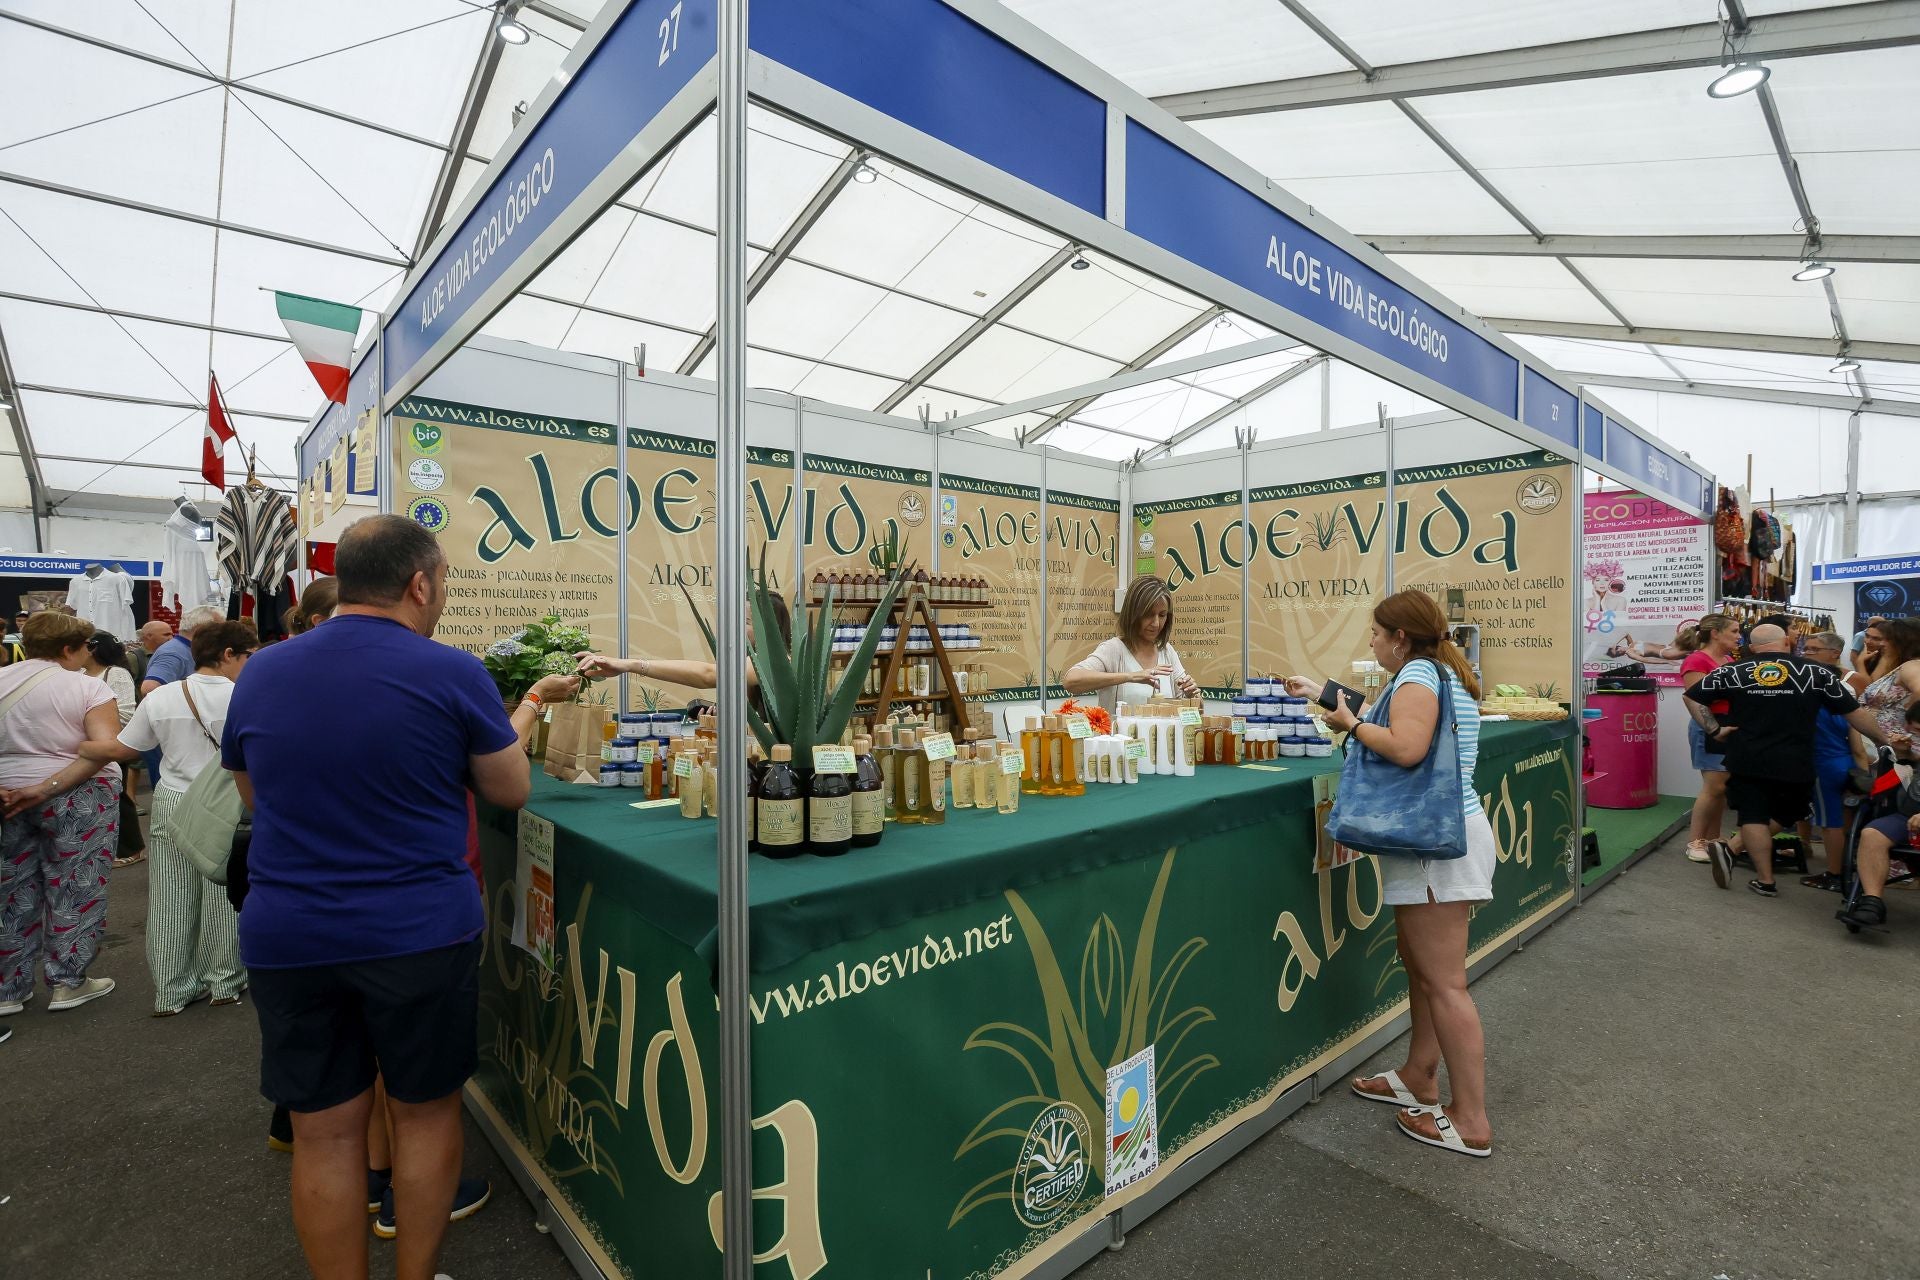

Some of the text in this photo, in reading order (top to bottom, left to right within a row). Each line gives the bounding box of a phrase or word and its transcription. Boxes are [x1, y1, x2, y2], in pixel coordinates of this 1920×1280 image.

[657, 0, 682, 67] 27
[421, 147, 555, 332] ALOE VIDA ECOLÓGICO
[1266, 235, 1448, 363] ALOE VIDA ECOLÓGICO
[1551, 404, 1559, 421] 27
[415, 427, 439, 441] bio
[29, 560, 81, 570] OCCITANIE
[648, 563, 712, 586] ALOE
[1831, 561, 1911, 575] LIMPIADOR PULIDOR DE
[1262, 578, 1372, 599] ALOE VERA
[1115, 1066, 1125, 1076] LA
[1105, 1081, 1113, 1128] BALEAR
[1018, 1144, 1033, 1176] ALOE
[1057, 1107, 1088, 1137] PRODUCT
[1024, 1159, 1084, 1209] CERTIFIED
[1106, 1160, 1157, 1196] BALEARS
